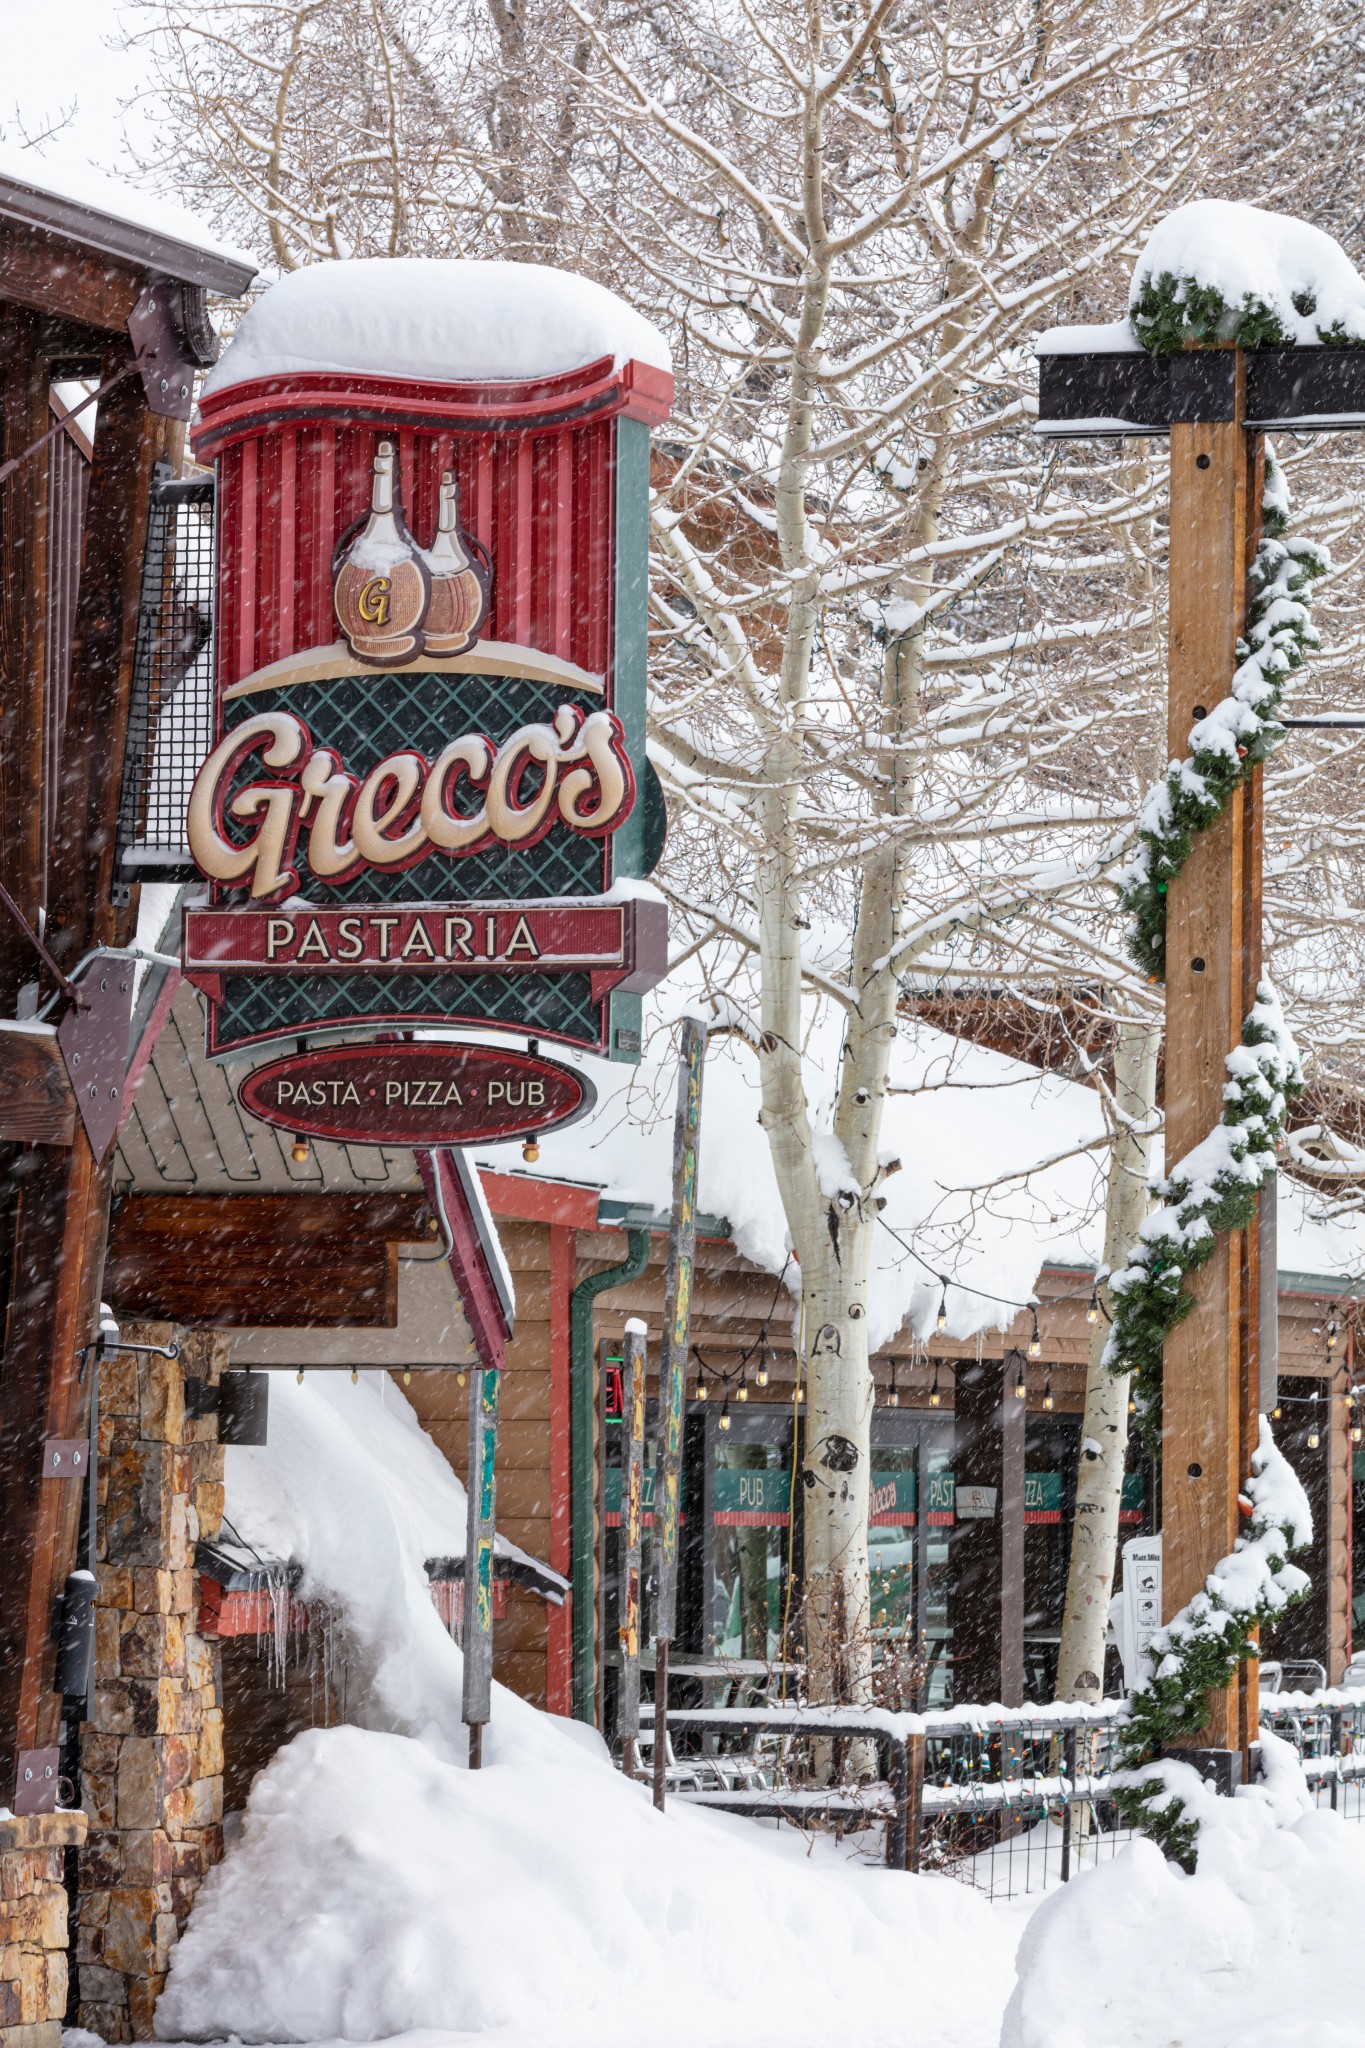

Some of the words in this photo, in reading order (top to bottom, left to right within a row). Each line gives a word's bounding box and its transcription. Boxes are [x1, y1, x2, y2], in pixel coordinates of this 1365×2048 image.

[358, 577, 391, 626] G
[188, 704, 632, 900] Greco's
[266, 915, 540, 960] PASTARIA
[277, 1081, 361, 1106] PASTA
[385, 1081, 463, 1106] PIZZA
[487, 1081, 545, 1106] PUB
[740, 1477, 764, 1505] PUB
[930, 1480, 955, 1507] PAST
